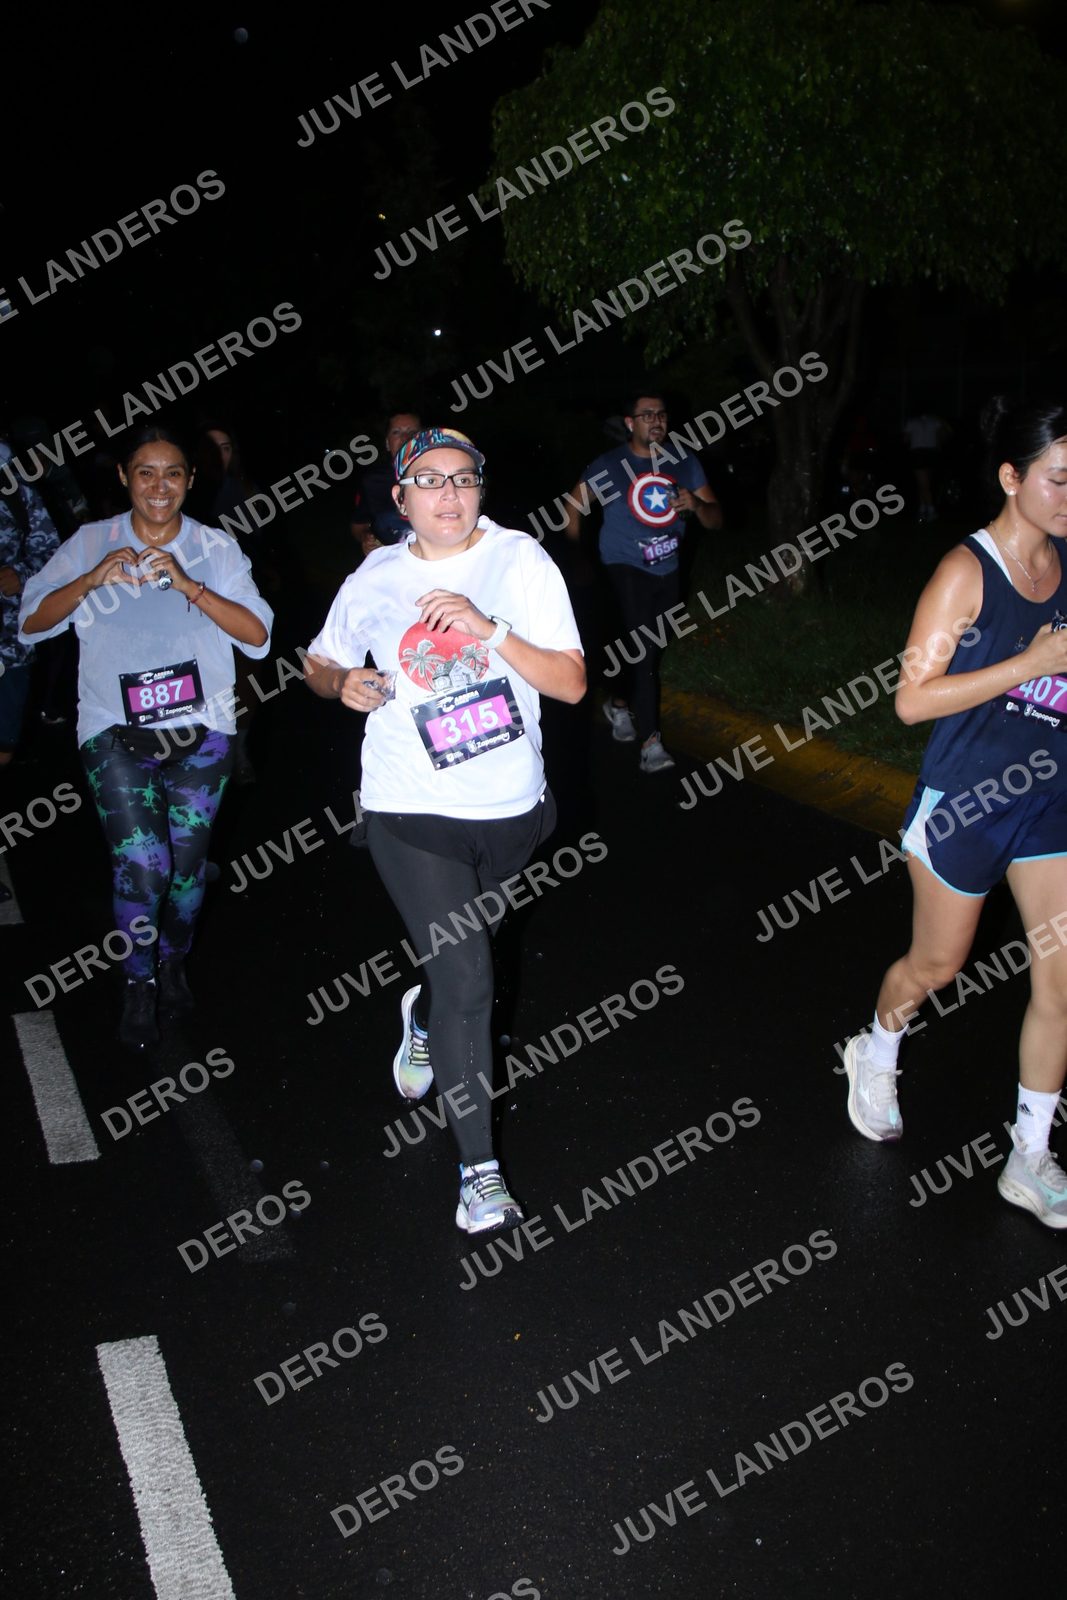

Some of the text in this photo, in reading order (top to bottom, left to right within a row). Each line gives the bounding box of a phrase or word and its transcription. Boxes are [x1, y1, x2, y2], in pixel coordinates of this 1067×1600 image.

[646, 538, 678, 558] 1656
[139, 680, 183, 709] 887
[1019, 676, 1067, 707] 407
[441, 701, 499, 746] 315
